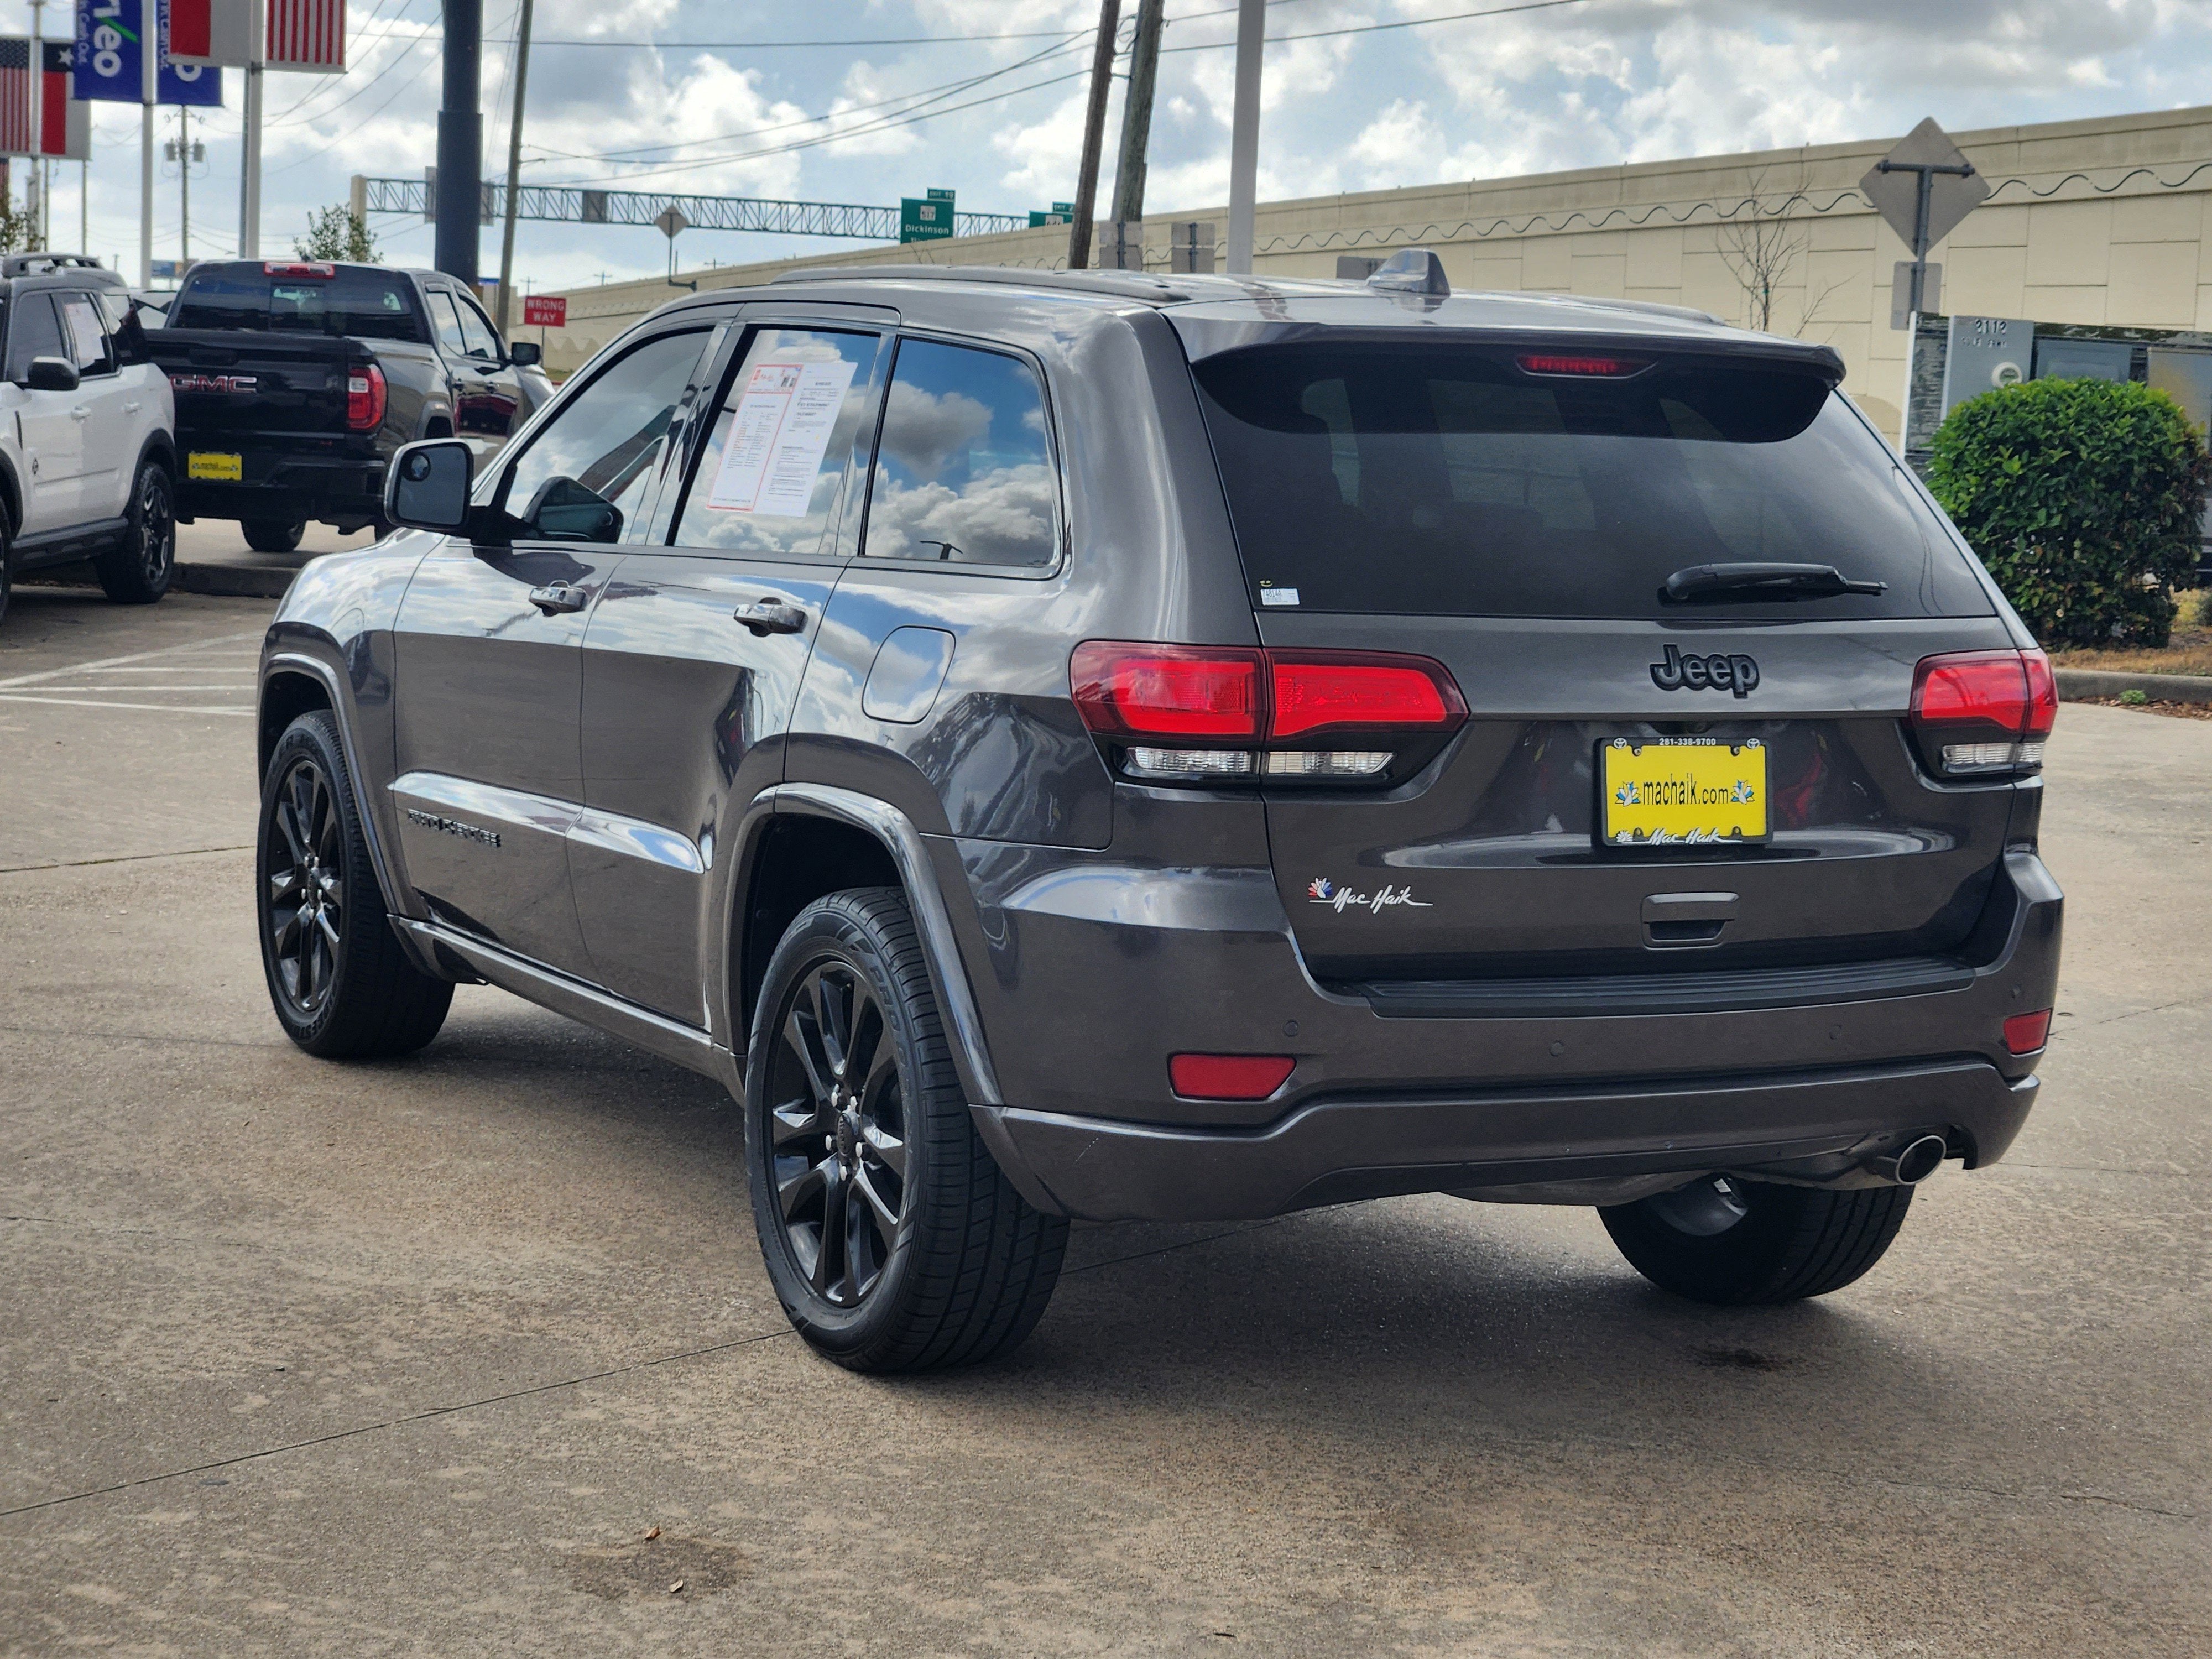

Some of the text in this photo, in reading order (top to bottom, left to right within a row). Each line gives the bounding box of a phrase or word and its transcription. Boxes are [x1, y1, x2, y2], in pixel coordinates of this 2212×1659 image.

[905, 223, 950, 235] Dickinson
[527, 299, 565, 311] WRONG
[533, 312, 557, 322] WAY
[170, 374, 257, 393] GMC
[1650, 643, 1760, 699] Jeep
[1659, 738, 1717, 746] 281-338-9700
[1643, 773, 1729, 806] machaik.com
[1648, 827, 1728, 846] Mac Haik
[1330, 884, 1424, 914] Mac Haik
